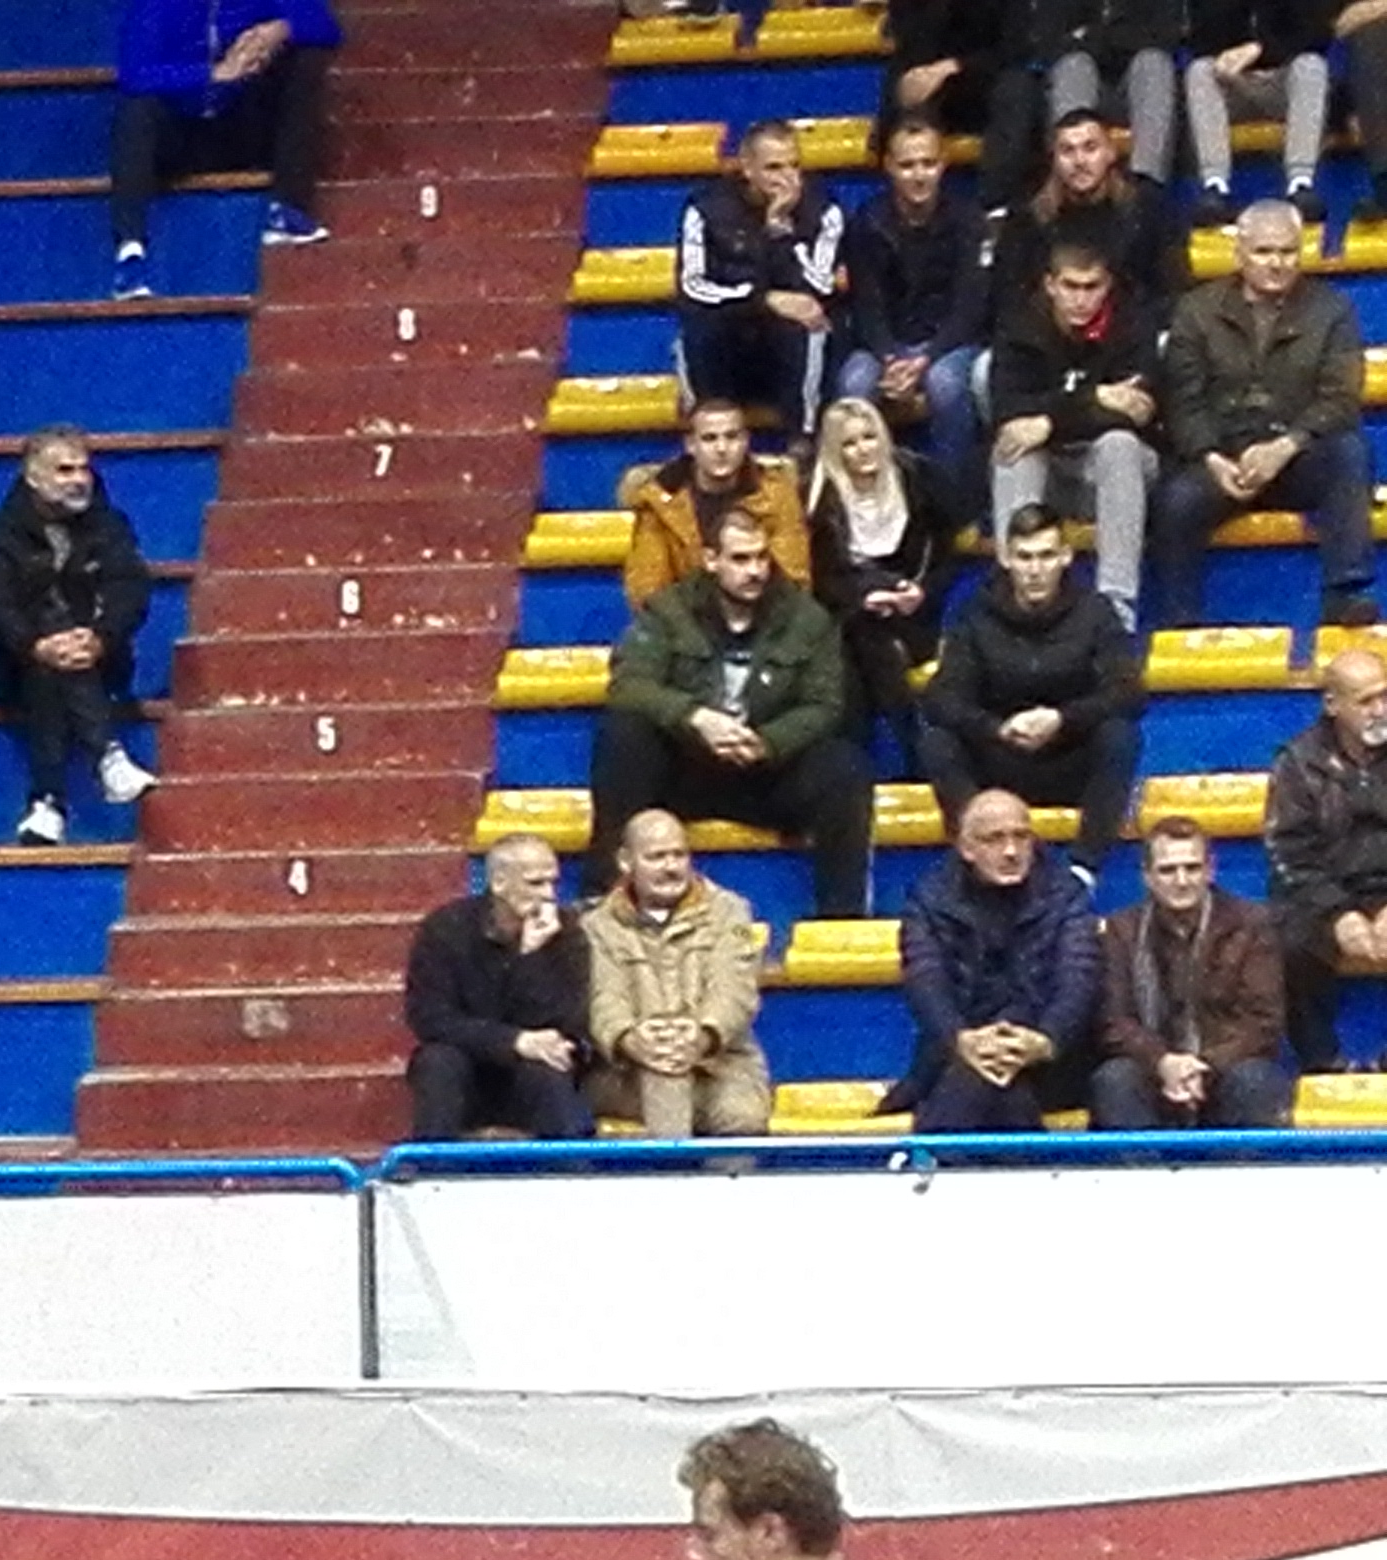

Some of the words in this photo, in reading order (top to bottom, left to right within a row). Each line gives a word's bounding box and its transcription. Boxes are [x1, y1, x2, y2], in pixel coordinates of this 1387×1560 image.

[374, 443, 393, 477] 7
[317, 715, 336, 751] 5
[288, 859, 309, 896] 4
